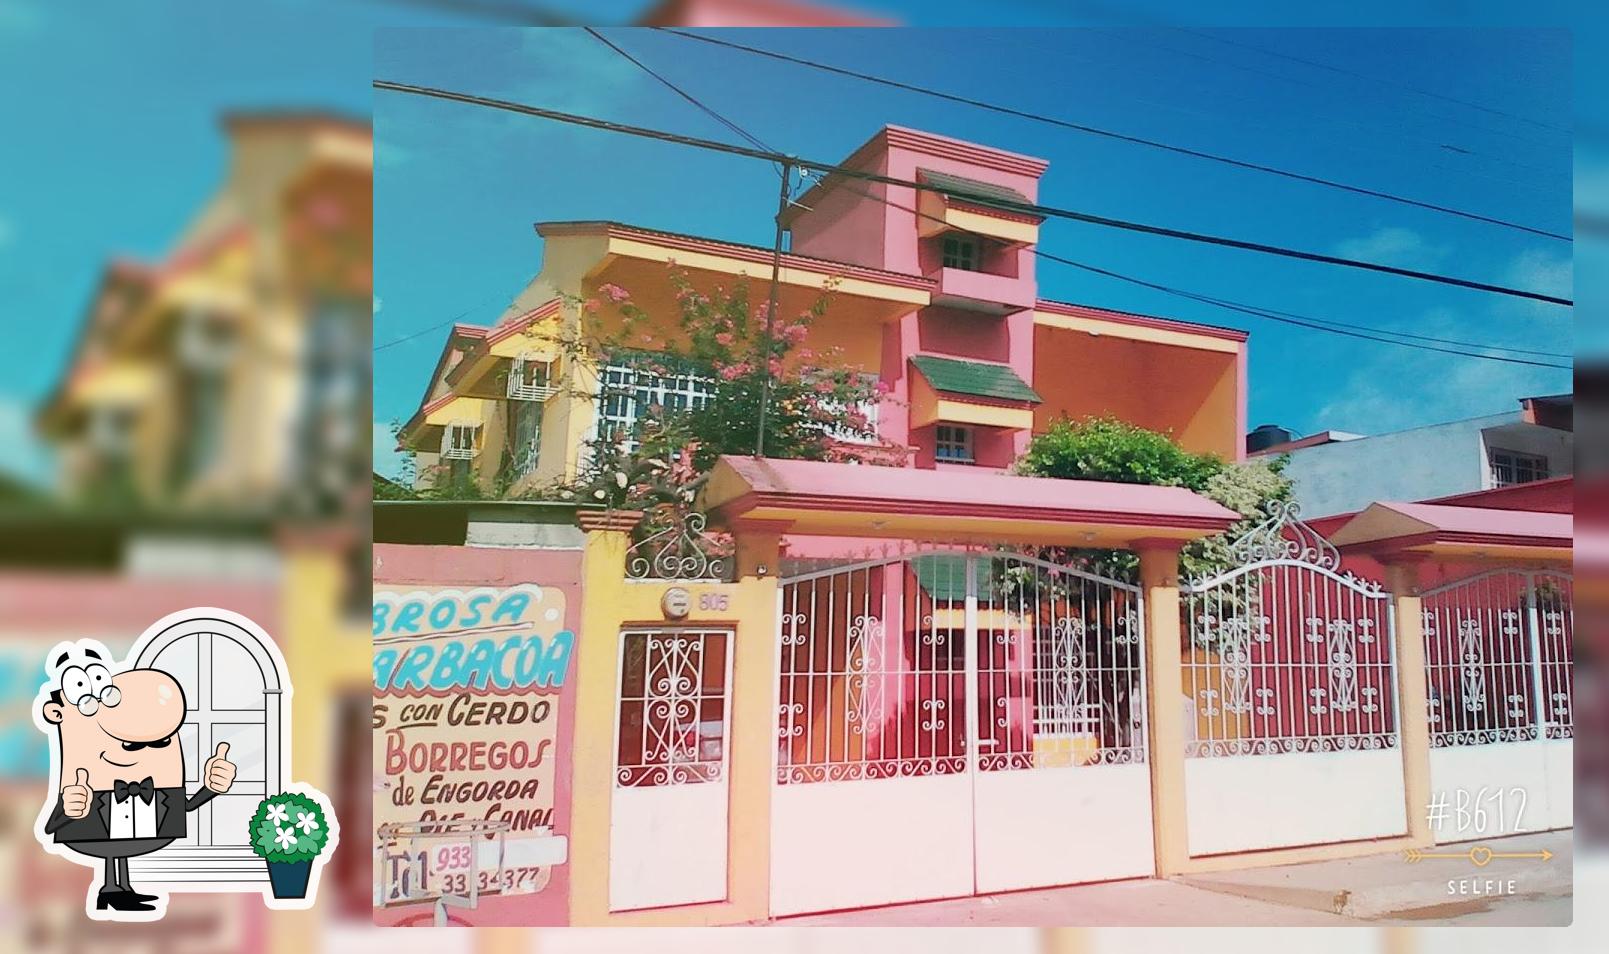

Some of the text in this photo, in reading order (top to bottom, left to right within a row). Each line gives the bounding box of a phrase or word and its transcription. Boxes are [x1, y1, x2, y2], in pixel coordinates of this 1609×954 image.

[400, 703, 443, 723] CON
[447, 692, 551, 727] CERDO
[385, 728, 552, 776] BORREGOS
[392, 774, 539, 807] de ENGORDA
[435, 846, 472, 872] 933
